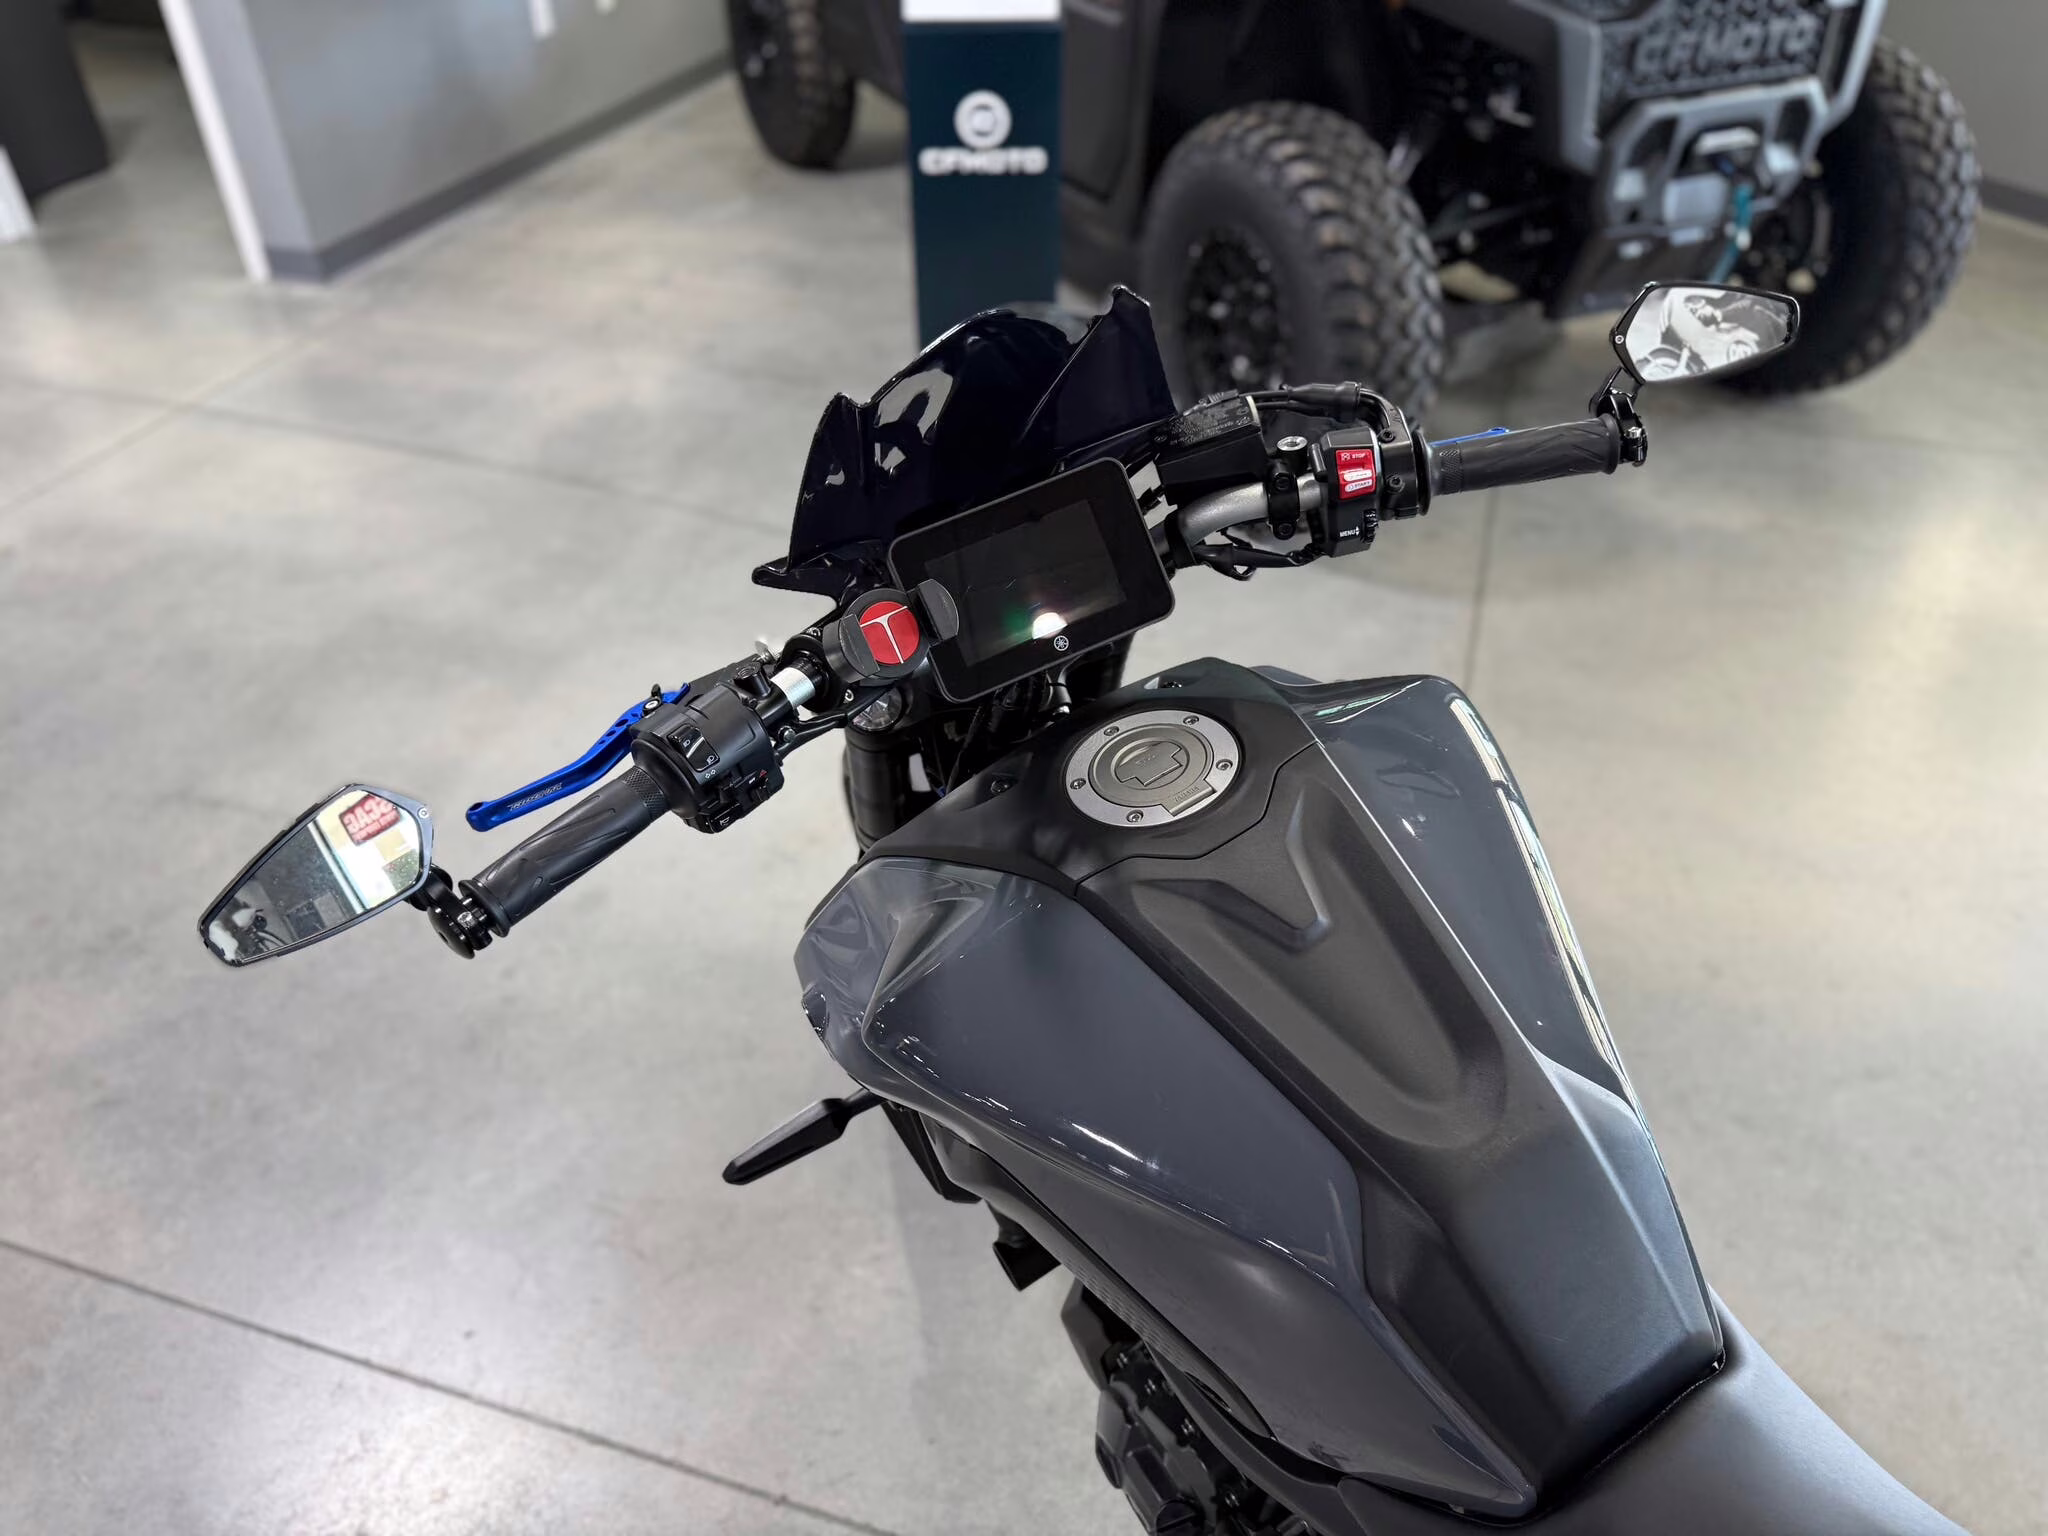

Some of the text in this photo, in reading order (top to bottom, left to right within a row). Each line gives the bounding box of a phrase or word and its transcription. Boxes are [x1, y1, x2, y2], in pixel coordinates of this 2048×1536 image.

[1633, 14, 1819, 75] CFMOTO
[918, 147, 1049, 175] CFMOTO
[1339, 529, 1356, 538] MENU
